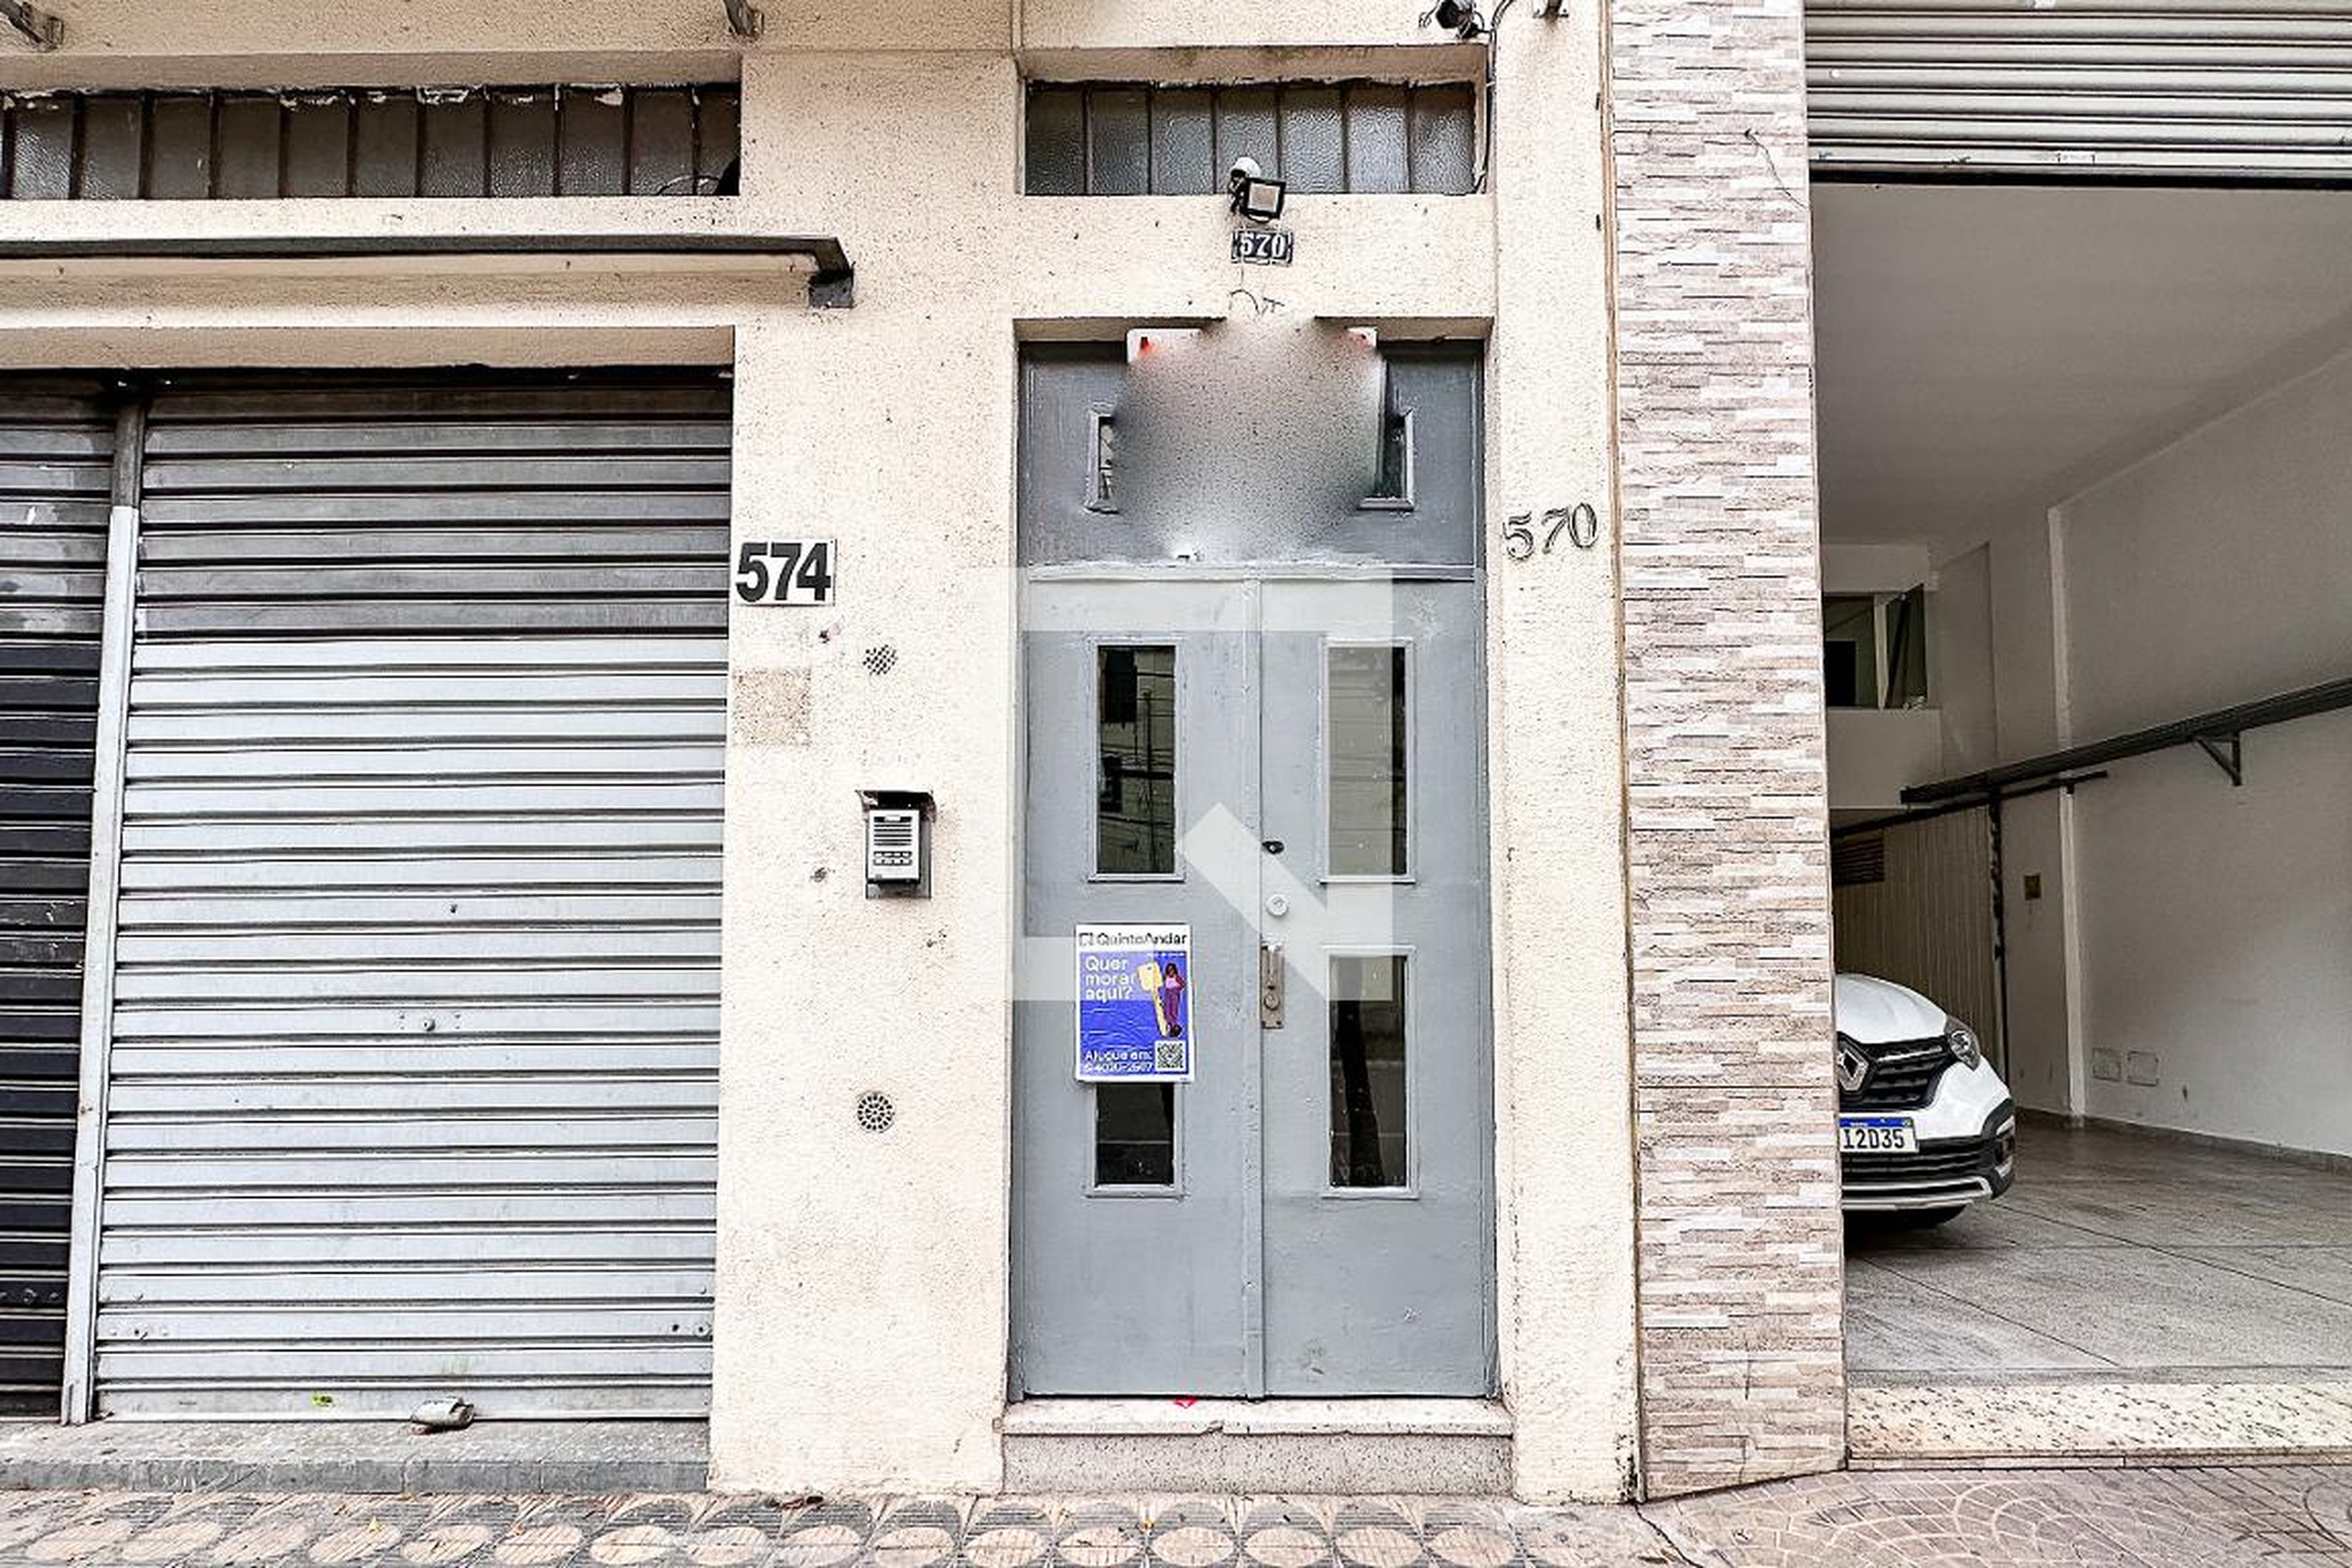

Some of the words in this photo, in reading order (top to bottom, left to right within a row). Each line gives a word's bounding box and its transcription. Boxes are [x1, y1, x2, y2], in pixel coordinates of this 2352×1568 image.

[1239, 232, 1286, 258] 570
[1502, 501, 1598, 560] 570
[735, 541, 831, 603] 574
[1085, 956, 1128, 972] Quer
[1085, 973, 1137, 986] morar
[1085, 986, 1133, 1003] aqui?
